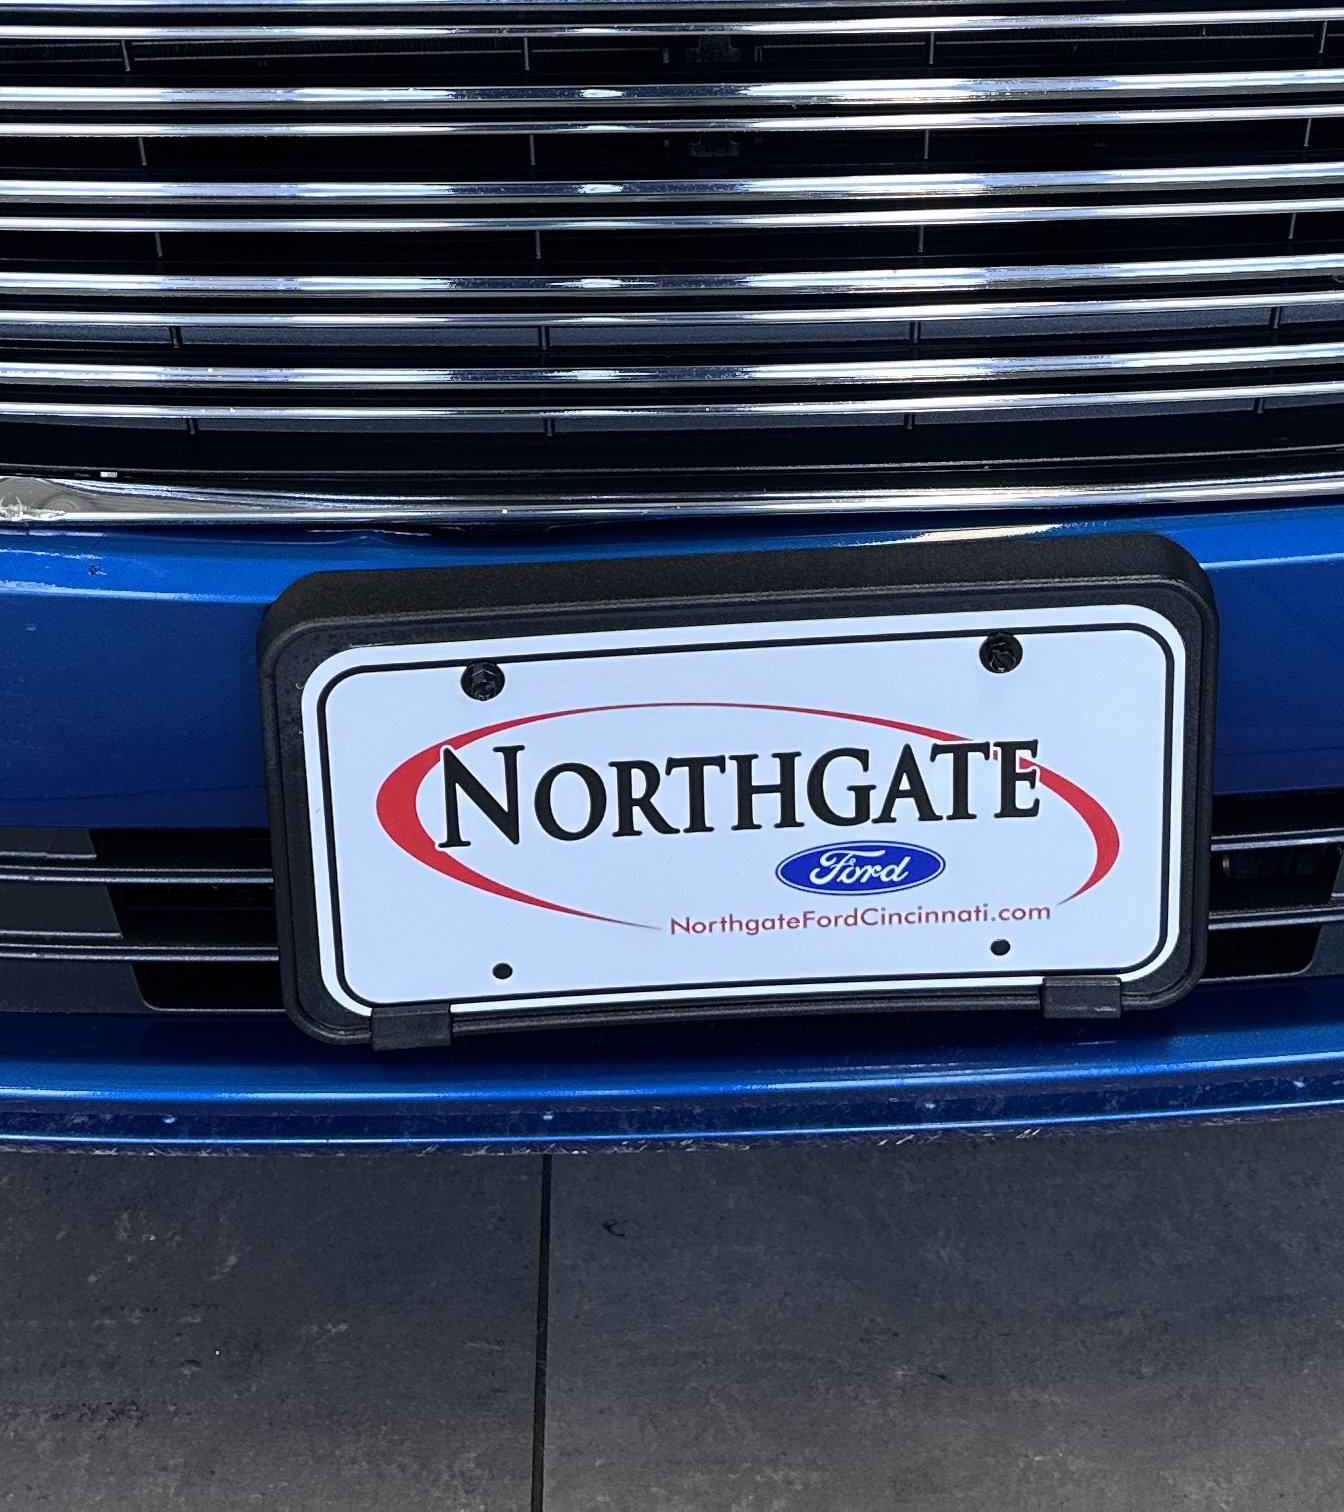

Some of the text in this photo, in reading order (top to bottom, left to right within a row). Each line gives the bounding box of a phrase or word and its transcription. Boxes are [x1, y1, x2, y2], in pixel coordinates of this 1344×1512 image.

[437, 738, 1041, 849] NORTHGATE
[809, 849, 912, 885] Ford
[670, 903, 1052, 936] NorthgateFordCincinnati.com
